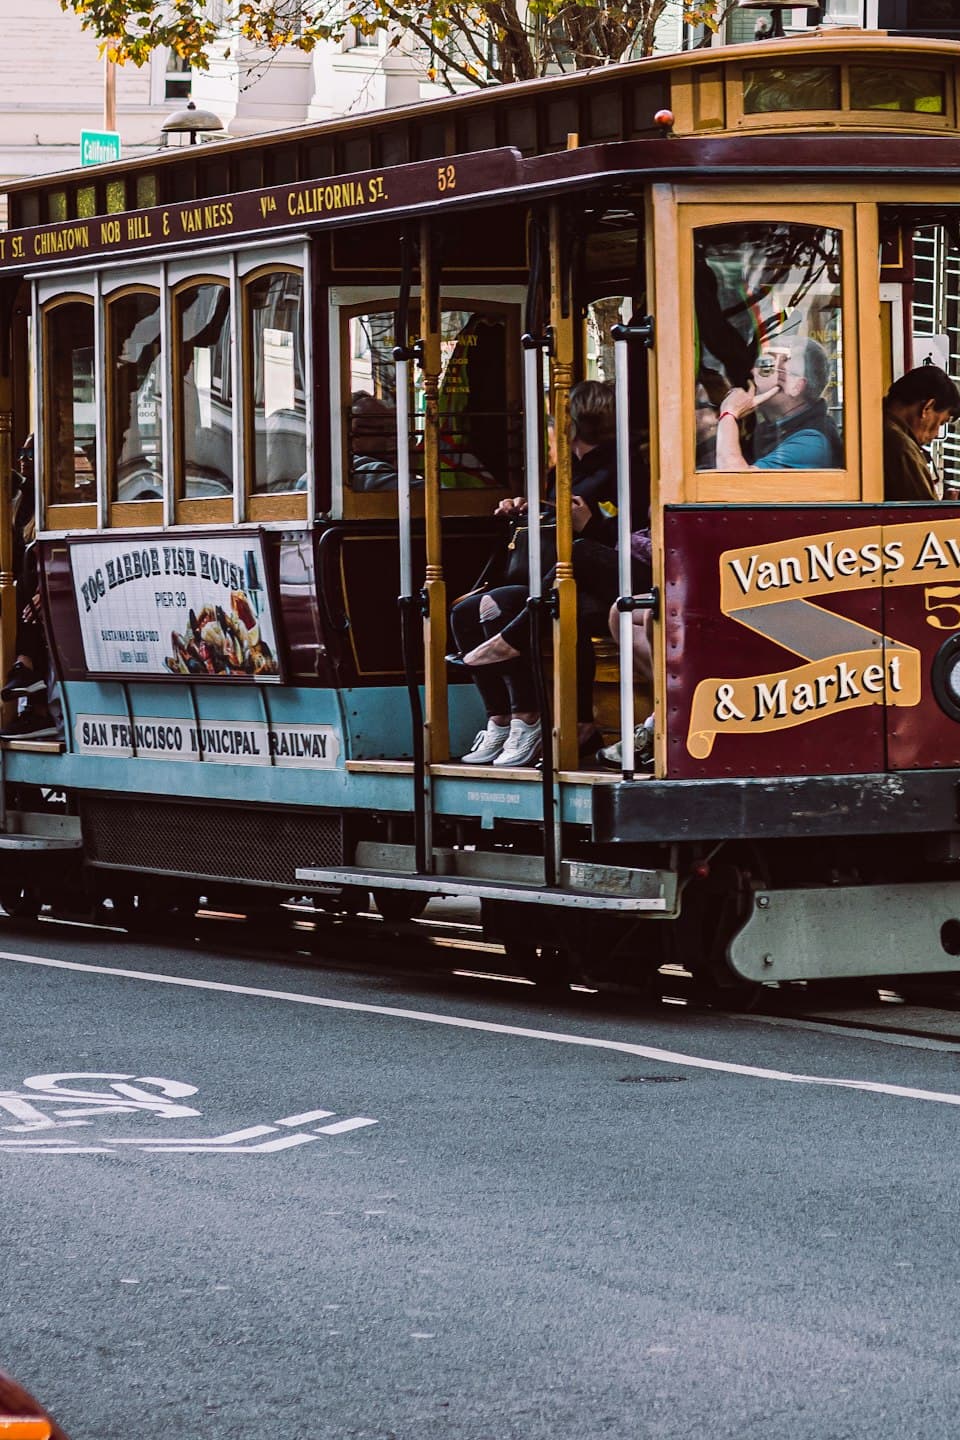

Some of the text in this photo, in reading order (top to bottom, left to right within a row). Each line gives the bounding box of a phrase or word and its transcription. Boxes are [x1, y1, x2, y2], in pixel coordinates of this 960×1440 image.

[84, 139, 117, 162] California
[437, 165, 456, 192] 52
[34, 227, 89, 255] CHINATOWN
[101, 220, 121, 244] NOB
[128, 216, 152, 240] HILL
[163, 212, 170, 236] &
[287, 181, 365, 216] CALIFORNIA
[81, 569, 106, 612] FOG
[105, 548, 161, 589] HARBOR
[162, 547, 197, 576] FISH
[155, 592, 186, 607] PIER 39
[713, 682, 746, 723] &
[751, 655, 903, 720] Market
[83, 722, 108, 746] SAN
[267, 731, 327, 758] RAILWAY
